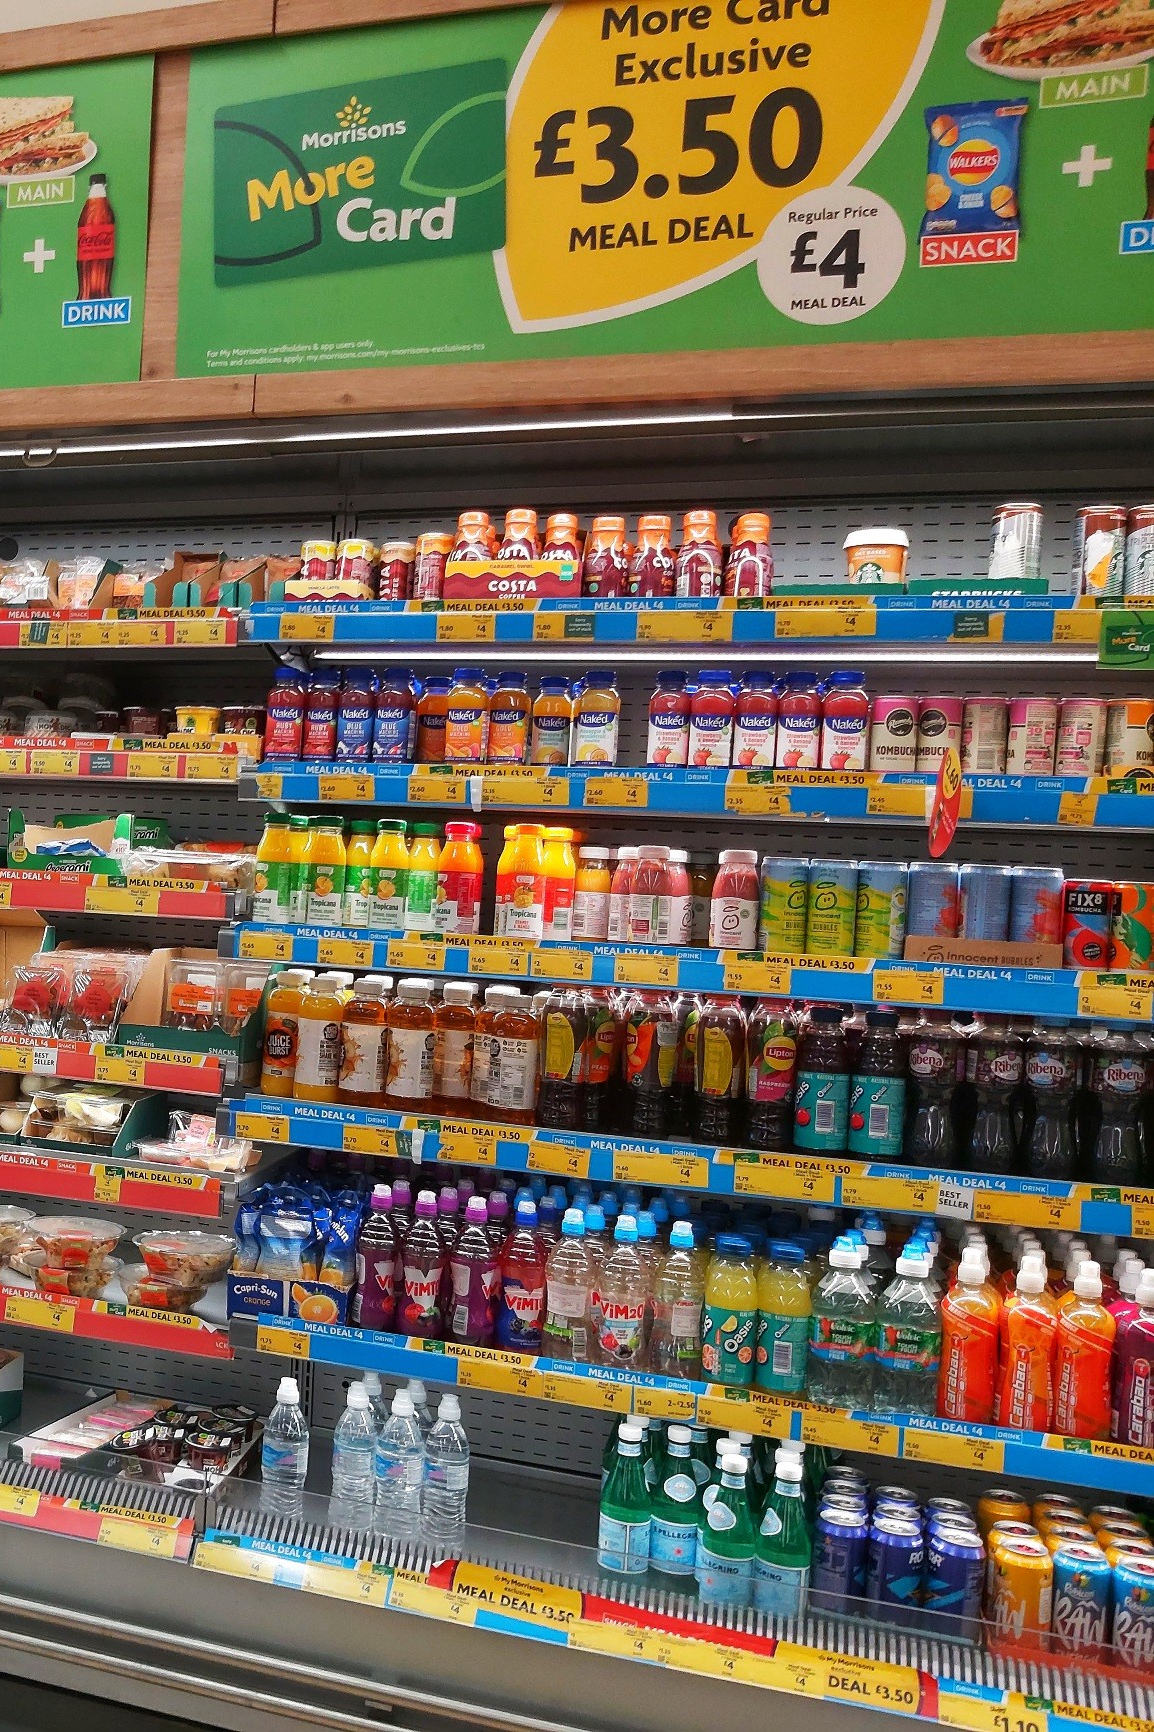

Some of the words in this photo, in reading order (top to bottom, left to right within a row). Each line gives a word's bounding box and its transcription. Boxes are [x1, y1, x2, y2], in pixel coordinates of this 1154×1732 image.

[600, 2, 714, 41] More
[725, 0, 831, 26] Card
[613, 38, 812, 87] Exclusive
[1056, 73, 1131, 100] MAIN
[301, 115, 407, 151] Morrisons
[533, 87, 824, 205] £3.50
[949, 155, 998, 169] WALKERS
[16, 182, 64, 202] MAIN
[246, 149, 376, 222] More
[335, 196, 456, 245] Card
[787, 208, 840, 225] Regular
[844, 204, 879, 219] Price
[569, 223, 661, 253] MEAL
[667, 212, 755, 245] DEAL
[789, 222, 866, 290] £4
[925, 237, 1013, 262] SNACK
[790, 298, 828, 312] MEAL
[831, 295, 867, 309] DEAL
[67, 302, 127, 323] DRINK
[487, 580, 537, 592] COSTA
[446, 602, 470, 612] MEAL
[472, 602, 500, 612] DEAL
[501, 601, 525, 611] £3.50
[271, 708, 298, 721] Naked
[342, 708, 369, 720] Naked
[448, 709, 475, 722] Naked
[579, 713, 609, 726] Naked
[654, 715, 684, 727] Naked
[776, 774, 803, 784] MEAL
[804, 774, 837, 785] DEAL
[839, 775, 865, 785] £3.50
[310, 898, 337, 909] Tropicana
[1068, 893, 1103, 906] FIX8
[509, 908, 537, 919] Tropicana
[1068, 906, 1102, 914] KOMBUCHA
[296, 928, 320, 938] MEAL
[321, 929, 347, 939] DEAL
[349, 930, 358, 939] £4
[768, 1049, 794, 1059] Lipton
[909, 1053, 943, 1068] Ribena
[1026, 1061, 1064, 1077] Ribena
[1107, 1068, 1144, 1083] Ribena
[294, 1107, 319, 1118] MEAL
[320, 1109, 345, 1120] DEAL
[346, 1112, 356, 1122] £4
[939, 1190, 961, 1199] BEST
[938, 1198, 968, 1210] SELLER
[233, 1281, 278, 1299] Capri-Sun
[127, 1305, 148, 1317] MEAL
[149, 1308, 171, 1320] DEAL
[173, 1311, 192, 1323] £3.50
[304, 1322, 329, 1333] MEAL
[330, 1326, 353, 1337] DEAL
[354, 1329, 363, 1340] £4
[724, 1319, 754, 1353] Oasis
[447, 1345, 472, 1357] MEAL
[474, 1349, 498, 1361] DEAL
[500, 1353, 522, 1365] £3.50
[909, 1416, 939, 1431] MEAL
[941, 1421, 970, 1435] DEAL
[971, 1426, 983, 1437] £4
[456, 1582, 496, 1603] MEAL
[499, 1593, 538, 1614] DEAL
[828, 1674, 871, 1696] DEAL
[875, 1683, 914, 1705] £3.50
